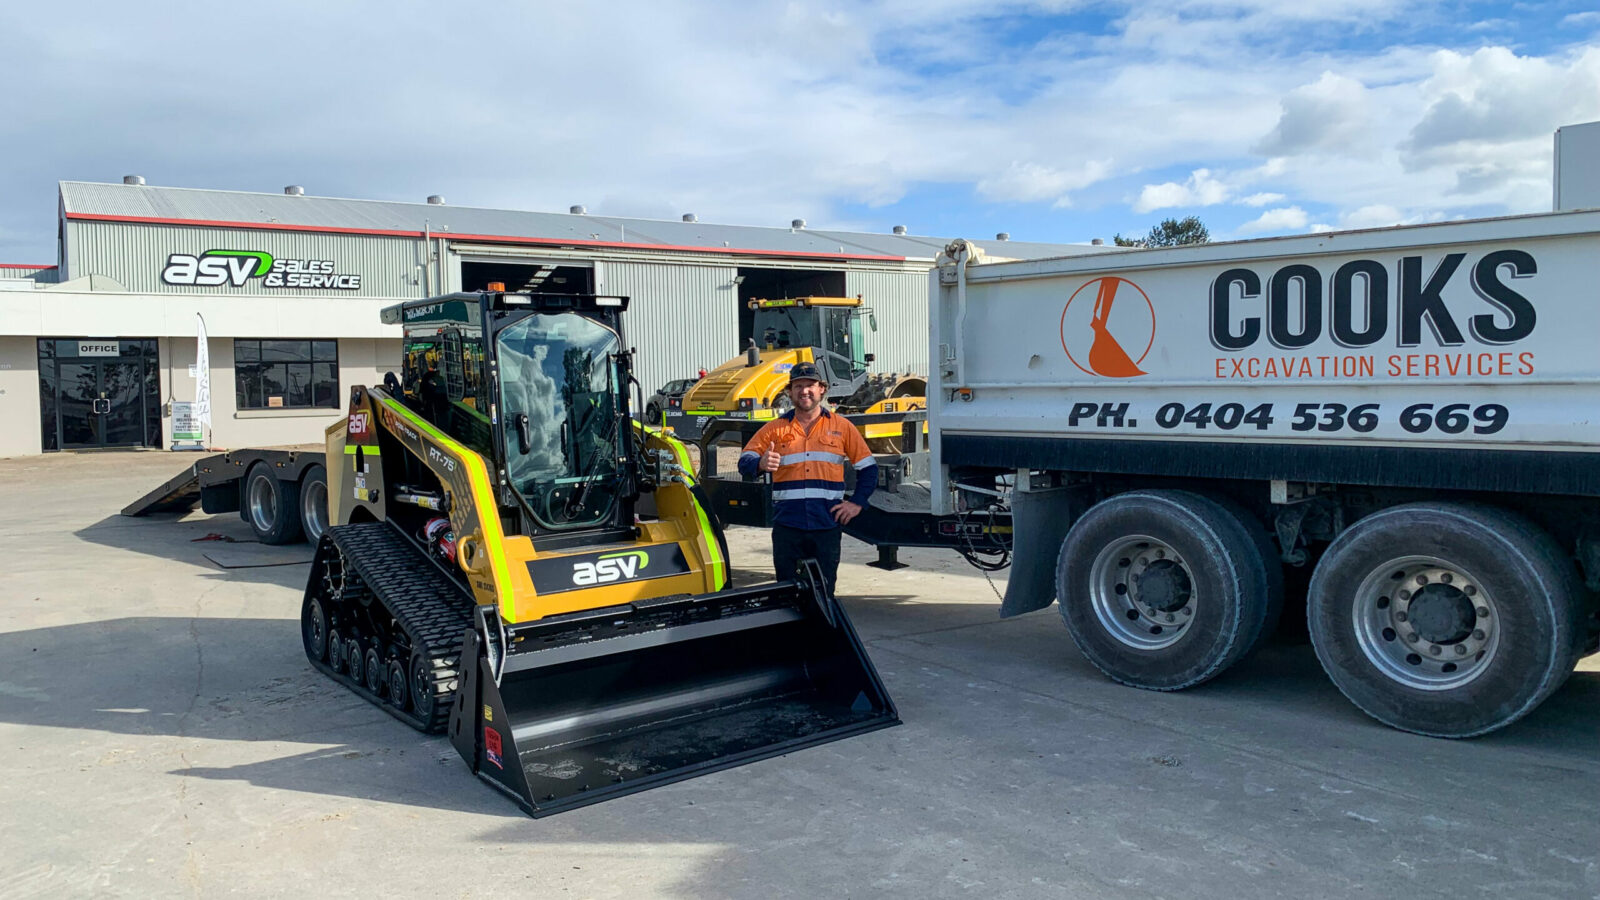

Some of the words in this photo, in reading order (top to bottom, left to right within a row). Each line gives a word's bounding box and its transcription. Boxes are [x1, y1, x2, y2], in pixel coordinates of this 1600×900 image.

[265, 273, 284, 287] &
[287, 274, 360, 289] SERVICE
[1208, 250, 1538, 350] COOKS
[1215, 355, 1374, 378] EXCAVATION
[1388, 352, 1535, 377] SERVICES
[1068, 402, 1137, 427] PH.
[1155, 402, 1274, 430] 0404
[1291, 403, 1381, 432] 536
[1399, 403, 1510, 434] 669
[429, 447, 454, 472] RT-75
